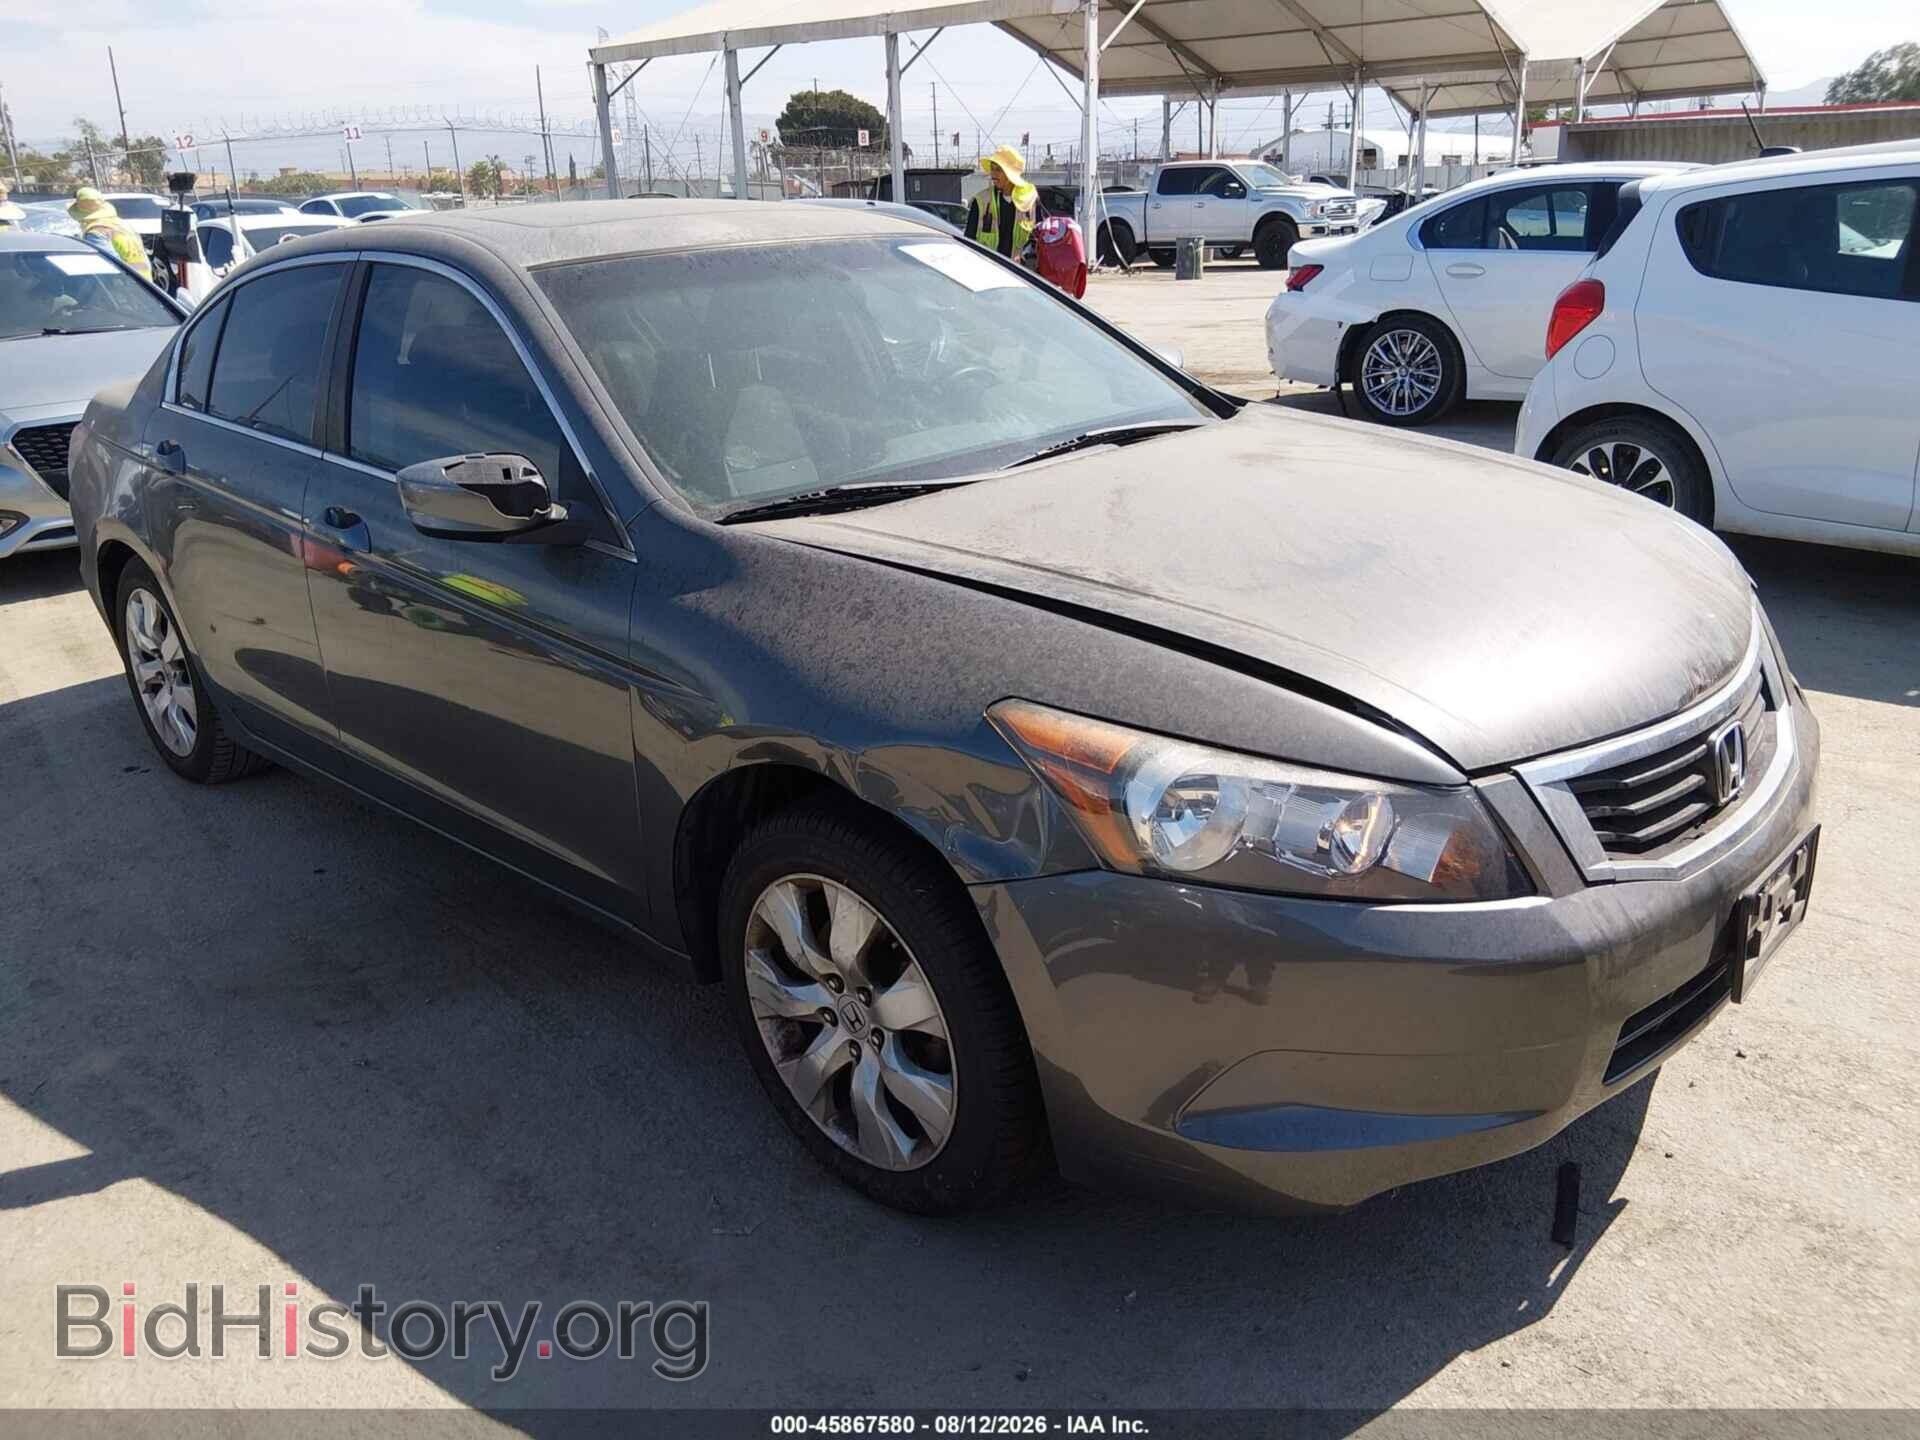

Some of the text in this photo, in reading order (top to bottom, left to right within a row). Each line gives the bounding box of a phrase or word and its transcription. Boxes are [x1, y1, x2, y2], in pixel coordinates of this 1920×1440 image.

[344, 127, 361, 140] 11
[760, 130, 768, 143] 9
[175, 134, 195, 150] 12
